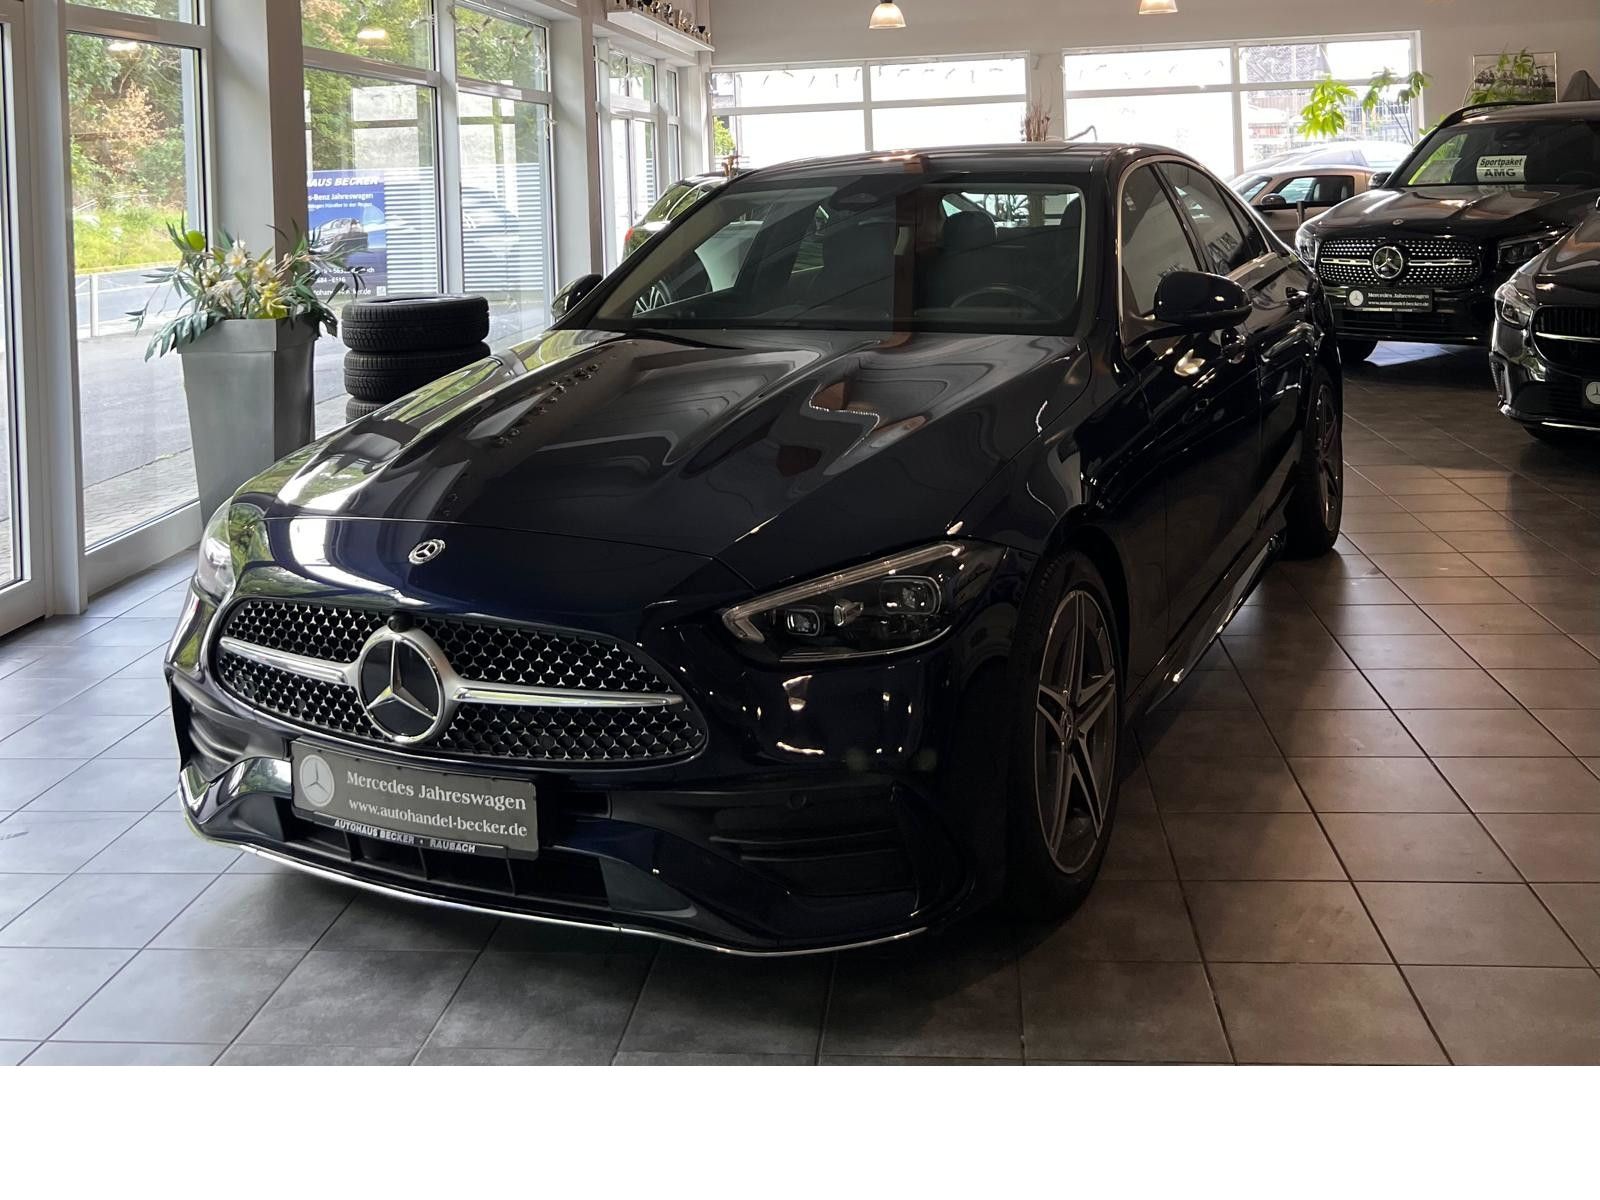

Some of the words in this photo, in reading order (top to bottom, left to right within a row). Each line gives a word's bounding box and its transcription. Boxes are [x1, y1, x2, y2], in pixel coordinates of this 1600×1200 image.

[1480, 158, 1523, 168] Sportpaket
[1484, 168, 1516, 177] AMG
[334, 177, 379, 187] BECKER
[331, 193, 374, 201] Jahreswagen
[346, 771, 415, 797] Mercedes
[418, 784, 527, 811] Jahreswagen
[349, 799, 528, 837] www.autohandel-becker.de
[334, 819, 378, 837] AUTOHAUS
[379, 829, 415, 845] BECKER
[429, 839, 476, 854] RAUBACH
